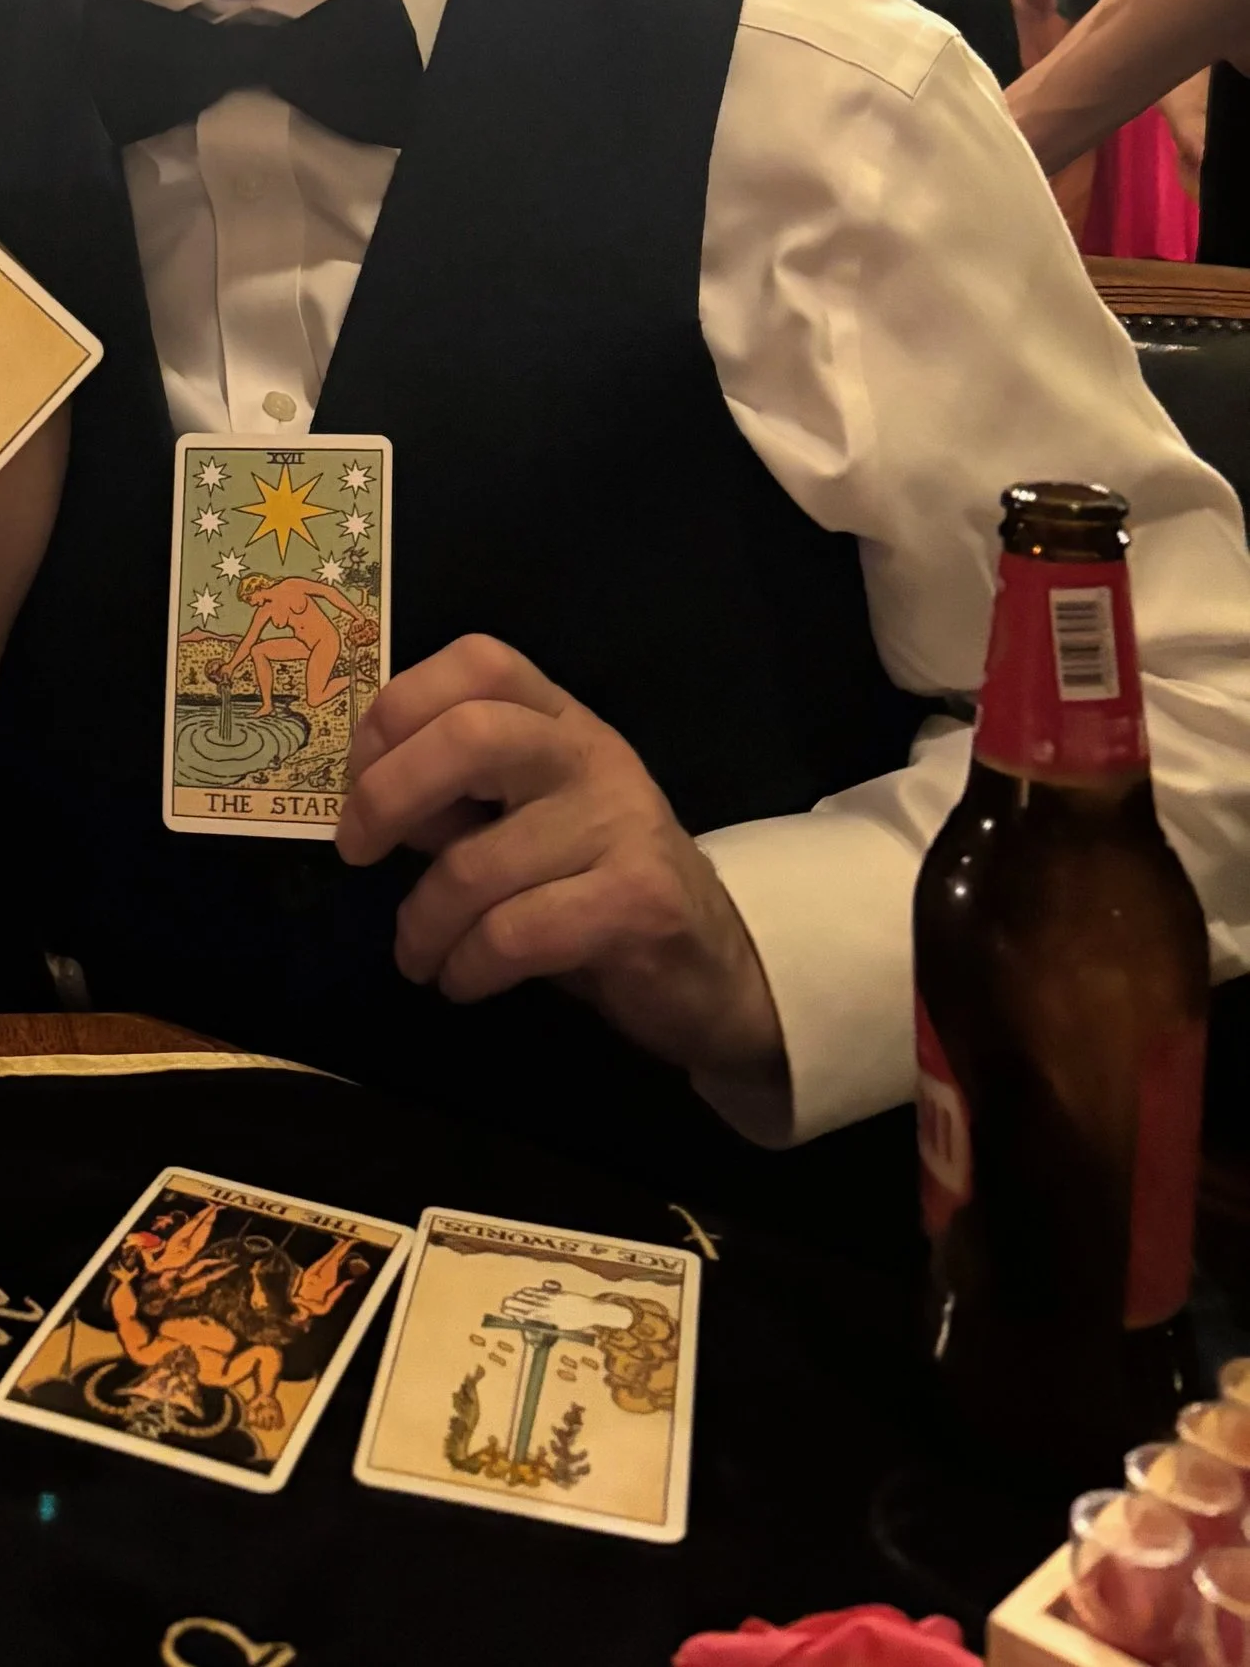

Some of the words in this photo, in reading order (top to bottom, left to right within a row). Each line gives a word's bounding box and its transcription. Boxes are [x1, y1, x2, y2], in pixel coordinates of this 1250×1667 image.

[266, 451, 305, 465] XVII
[204, 793, 253, 814] THE
[270, 796, 340, 817] STAR
[300, 1210, 360, 1237] THE
[439, 1218, 579, 1253] SWORDS.
[617, 1249, 678, 1270] ACE
